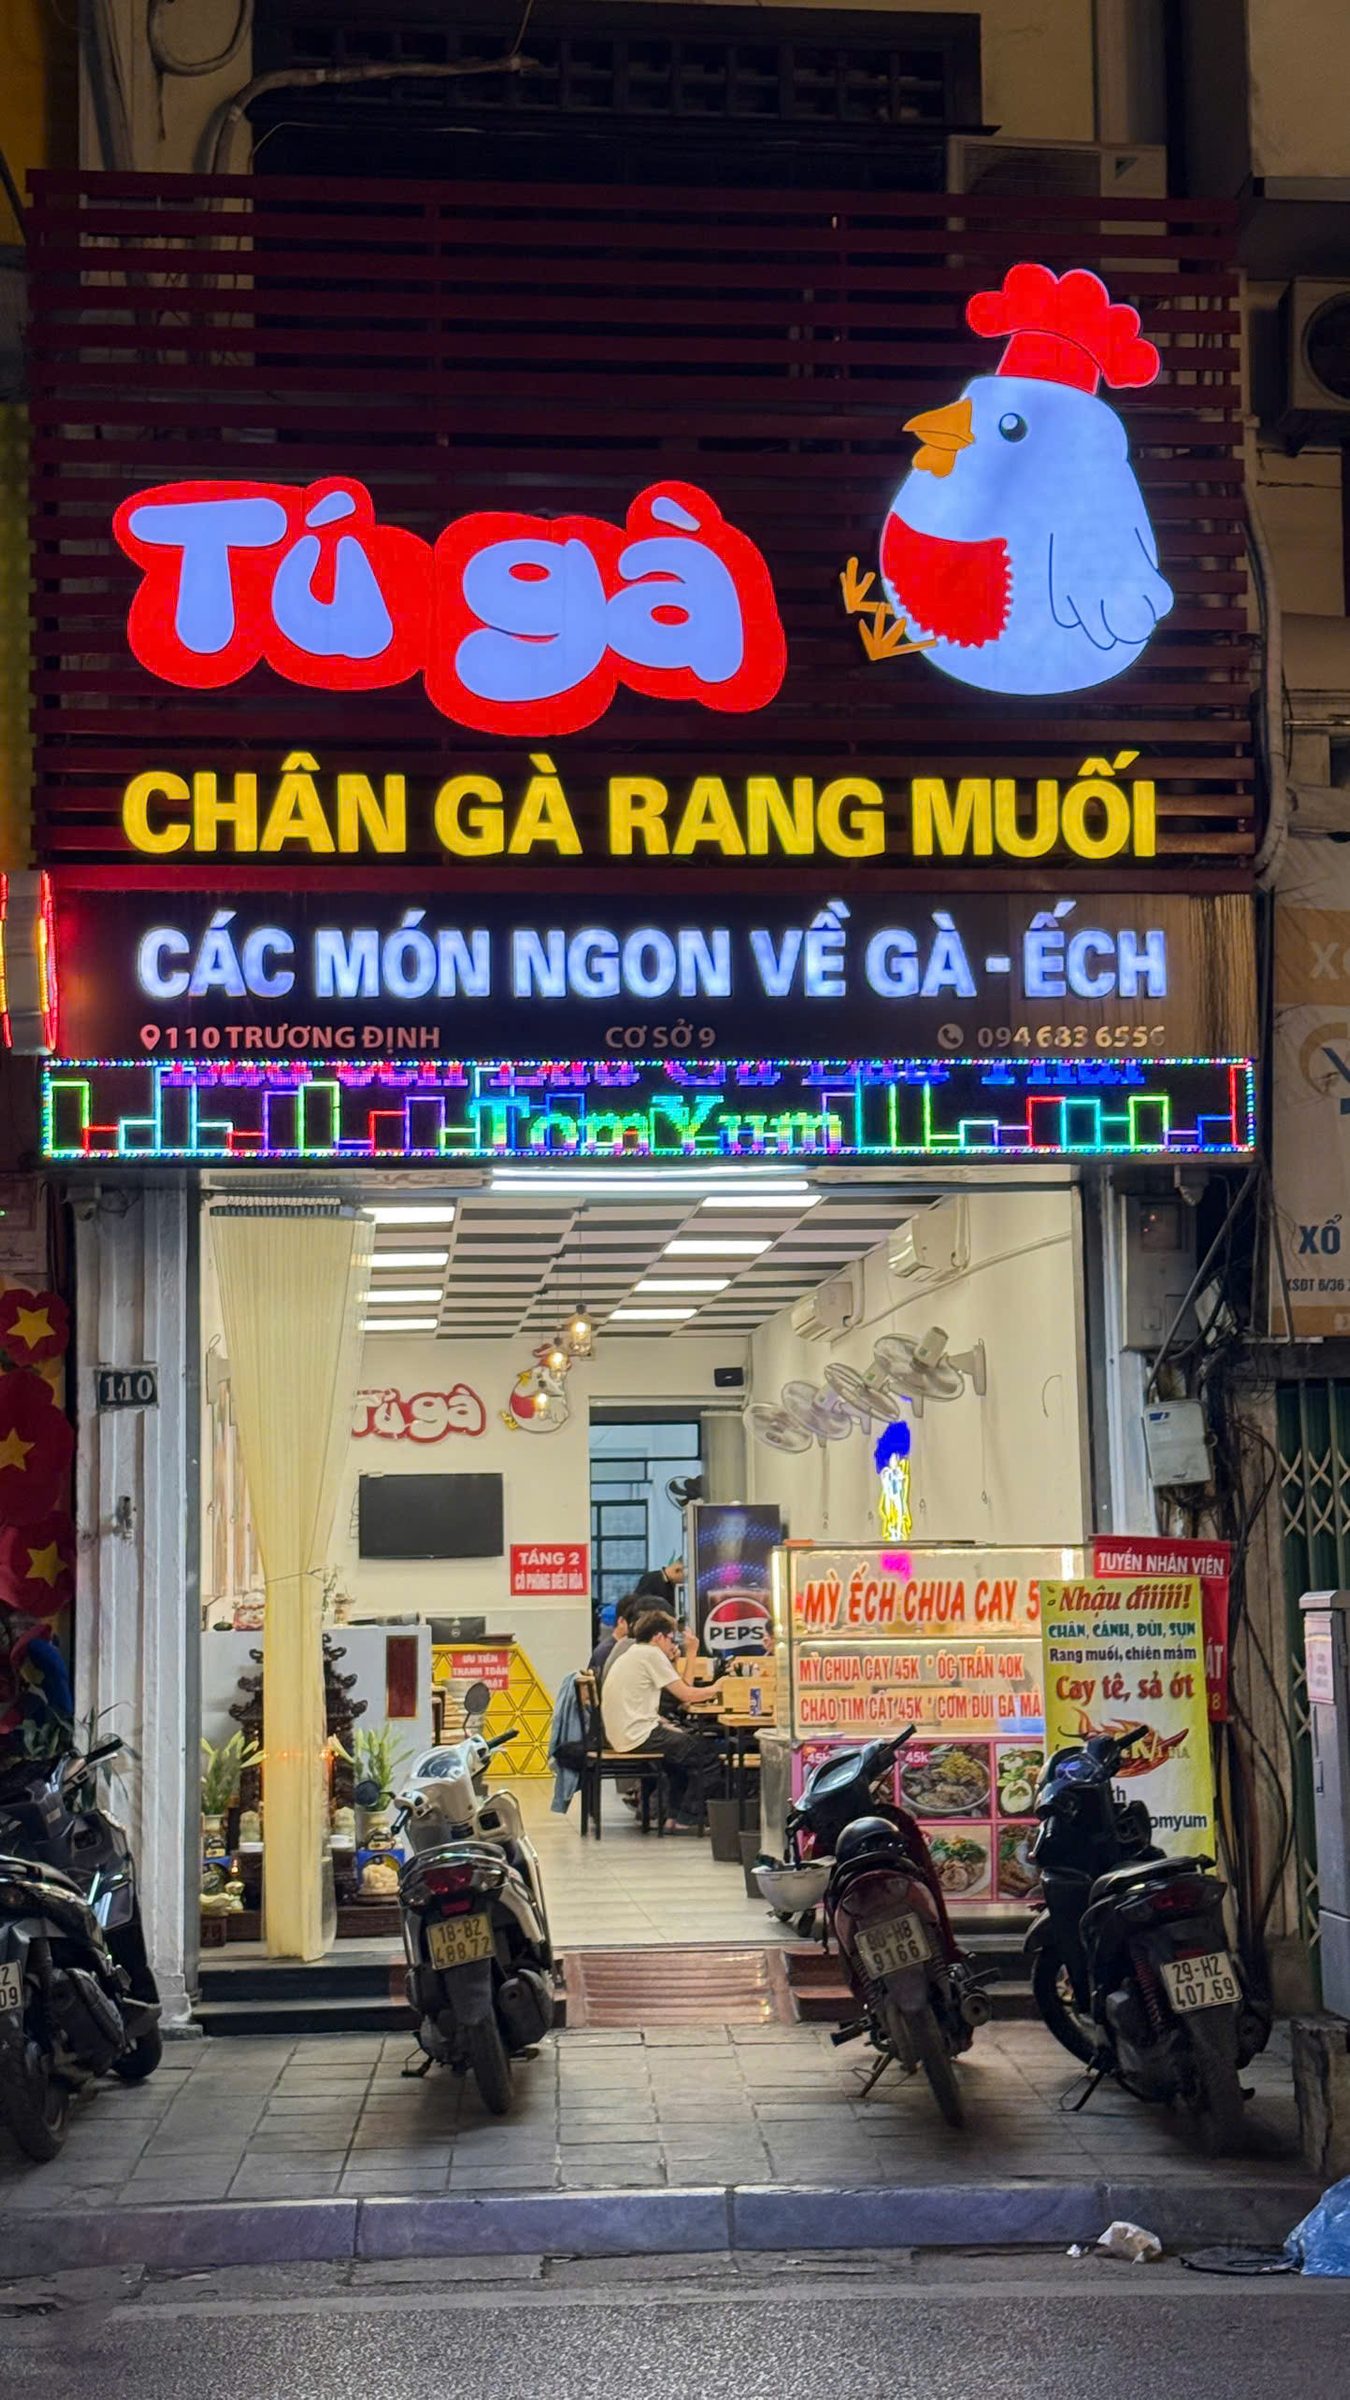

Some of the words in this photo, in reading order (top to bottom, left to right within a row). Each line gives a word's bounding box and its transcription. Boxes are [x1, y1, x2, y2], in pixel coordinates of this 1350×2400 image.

[128, 490, 394, 660] Tú
[454, 495, 745, 703] gà
[122, 751, 407, 855] CHÂN
[434, 753, 584, 857] GÀ
[608, 776, 886, 858] RANG
[911, 750, 1156, 860] MUỐI
[137, 907, 296, 999] CÁC
[314, 907, 491, 999] MÓN
[512, 927, 732, 999] NGON
[749, 899, 851, 998] VỀ
[865, 910, 978, 999] GÀ
[1024, 899, 1168, 999] ẾCH
[1311, 942, 1350, 980] X
[165, 1027, 221, 1049] 110
[224, 1022, 356, 1050] TRƯƠNG
[361, 1026, 440, 1055] ĐỊNH
[605, 1025, 648, 1049] CƠ
[652, 1017, 694, 1049] SỞ
[698, 1026, 717, 1049] 9
[977, 1026, 1031, 1048] 094
[1036, 1025, 1089, 1048] 683
[1095, 1025, 1166, 1048] 6556
[104, 1374, 153, 1402] 110
[568, 1551, 580, 1566] 2
[1146, 1552, 1188, 1574] NHÂN
[1191, 1554, 1225, 1576] VIÊN
[804, 1569, 842, 1626] MỲ
[848, 1561, 898, 1623] ẾCH
[903, 1579, 966, 1623] CHUA
[974, 1579, 1018, 1623] CAY
[1058, 1584, 1122, 1618] Nhậu
[709, 1626, 764, 1641] PEPS
[1048, 1621, 1089, 1640] CHÂN,
[1093, 1619, 1135, 1639] CÁNH,
[1050, 1647, 1083, 1664] Rang
[1085, 1643, 1123, 1663] muối,
[1125, 1645, 1161, 1661] chiên
[824, 1657, 861, 1681] CHUA
[864, 1656, 892, 1680] CAY
[894, 1656, 920, 1680] 45K
[998, 1656, 1025, 1680] 40K
[1056, 1675, 1097, 1707] Cay
[1102, 1672, 1131, 1705] tê,
[1138, 1670, 1163, 1699] sả
[1170, 1671, 1195, 1700] ớt
[839, 1697, 865, 1720] TIM
[898, 1696, 923, 1720] 45K
[905, 1752, 929, 1764] 45k
[1150, 1815, 1207, 1832] omyum
[873, 1939, 920, 1972] 9166
[1172, 1955, 1222, 1984] 29-H2
[1175, 1976, 1235, 2008] 407.69
